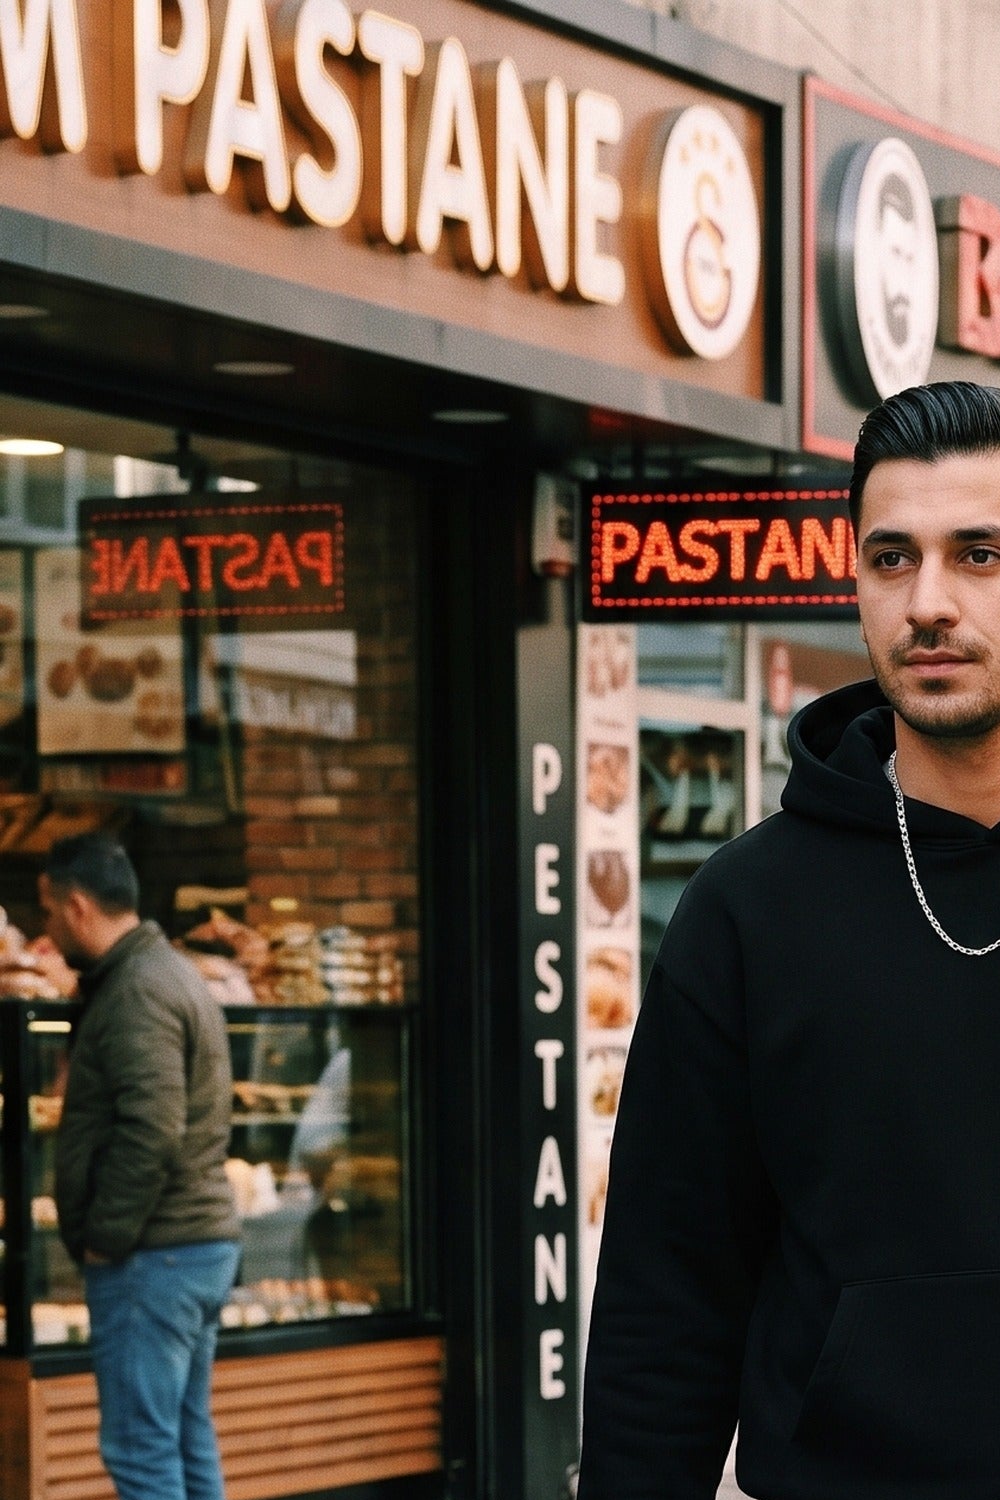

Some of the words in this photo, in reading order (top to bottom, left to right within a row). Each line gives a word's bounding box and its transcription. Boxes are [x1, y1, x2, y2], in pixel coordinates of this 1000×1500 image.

[133, 0, 626, 304] PASTANE
[601, 517, 858, 583] PASTAN
[532, 743, 567, 1400] PESTANE
